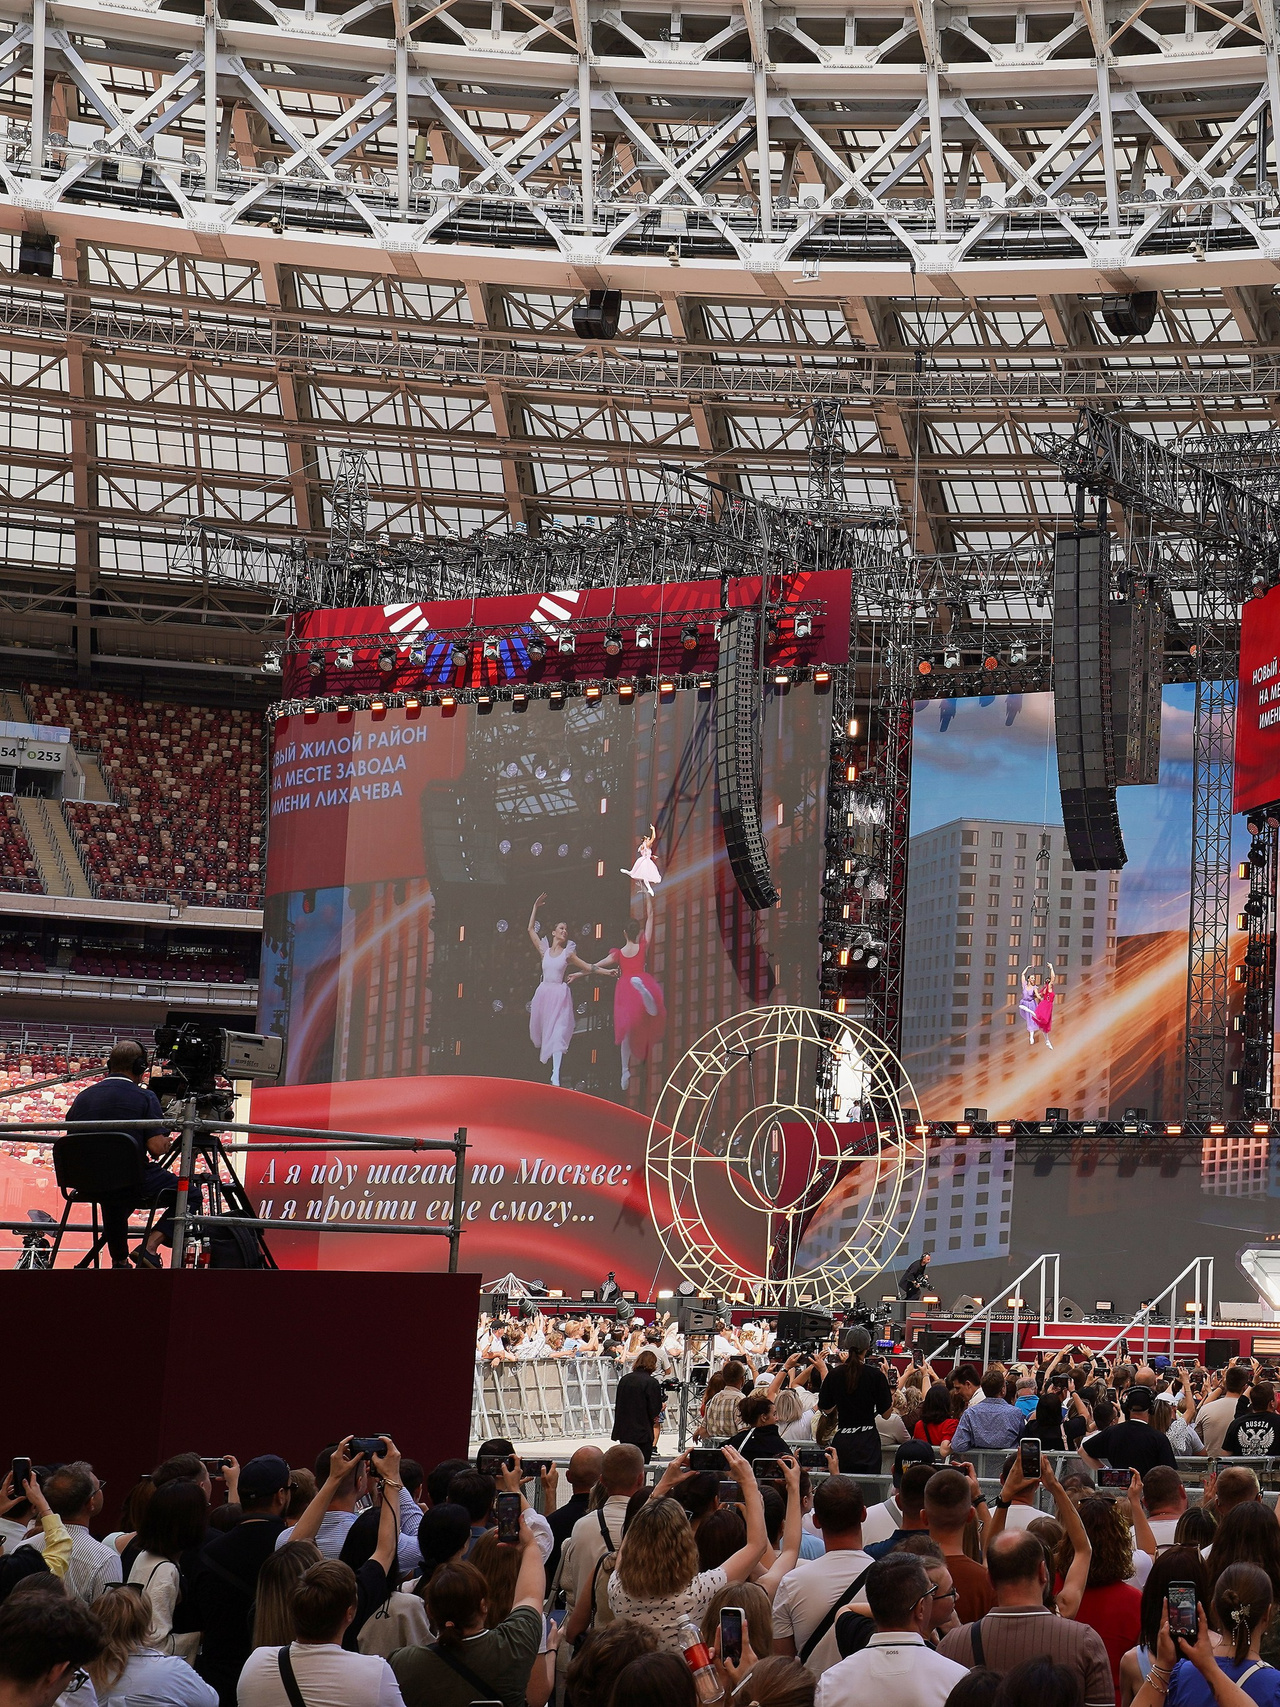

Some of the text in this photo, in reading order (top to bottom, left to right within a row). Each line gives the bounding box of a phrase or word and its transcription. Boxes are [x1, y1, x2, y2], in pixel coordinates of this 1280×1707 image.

[1252, 656, 1278, 686] НОВЫЙ
[1258, 687, 1269, 706] НА
[37, 751, 61, 762] 253
[300, 731, 362, 759] ЖИЛОЙ
[367, 725, 428, 749] РАЙОН
[284, 764, 332, 788] МЕСТЕ
[336, 754, 407, 780] ЗАВОДА
[314, 780, 403, 808] ЛИХАЧЕВА
[259, 1158, 276, 1184] А
[284, 1164, 302, 1185] я
[310, 1156, 358, 1191] иду
[470, 1163, 505, 1185] по
[512, 1157, 632, 1186] Москве:
[258, 1199, 274, 1219] и
[279, 1199, 298, 1220] я
[305, 1189, 417, 1223] пройти
[488, 1200, 595, 1228] смогу...
[1245, 1420, 1269, 1429] RUSSIA
